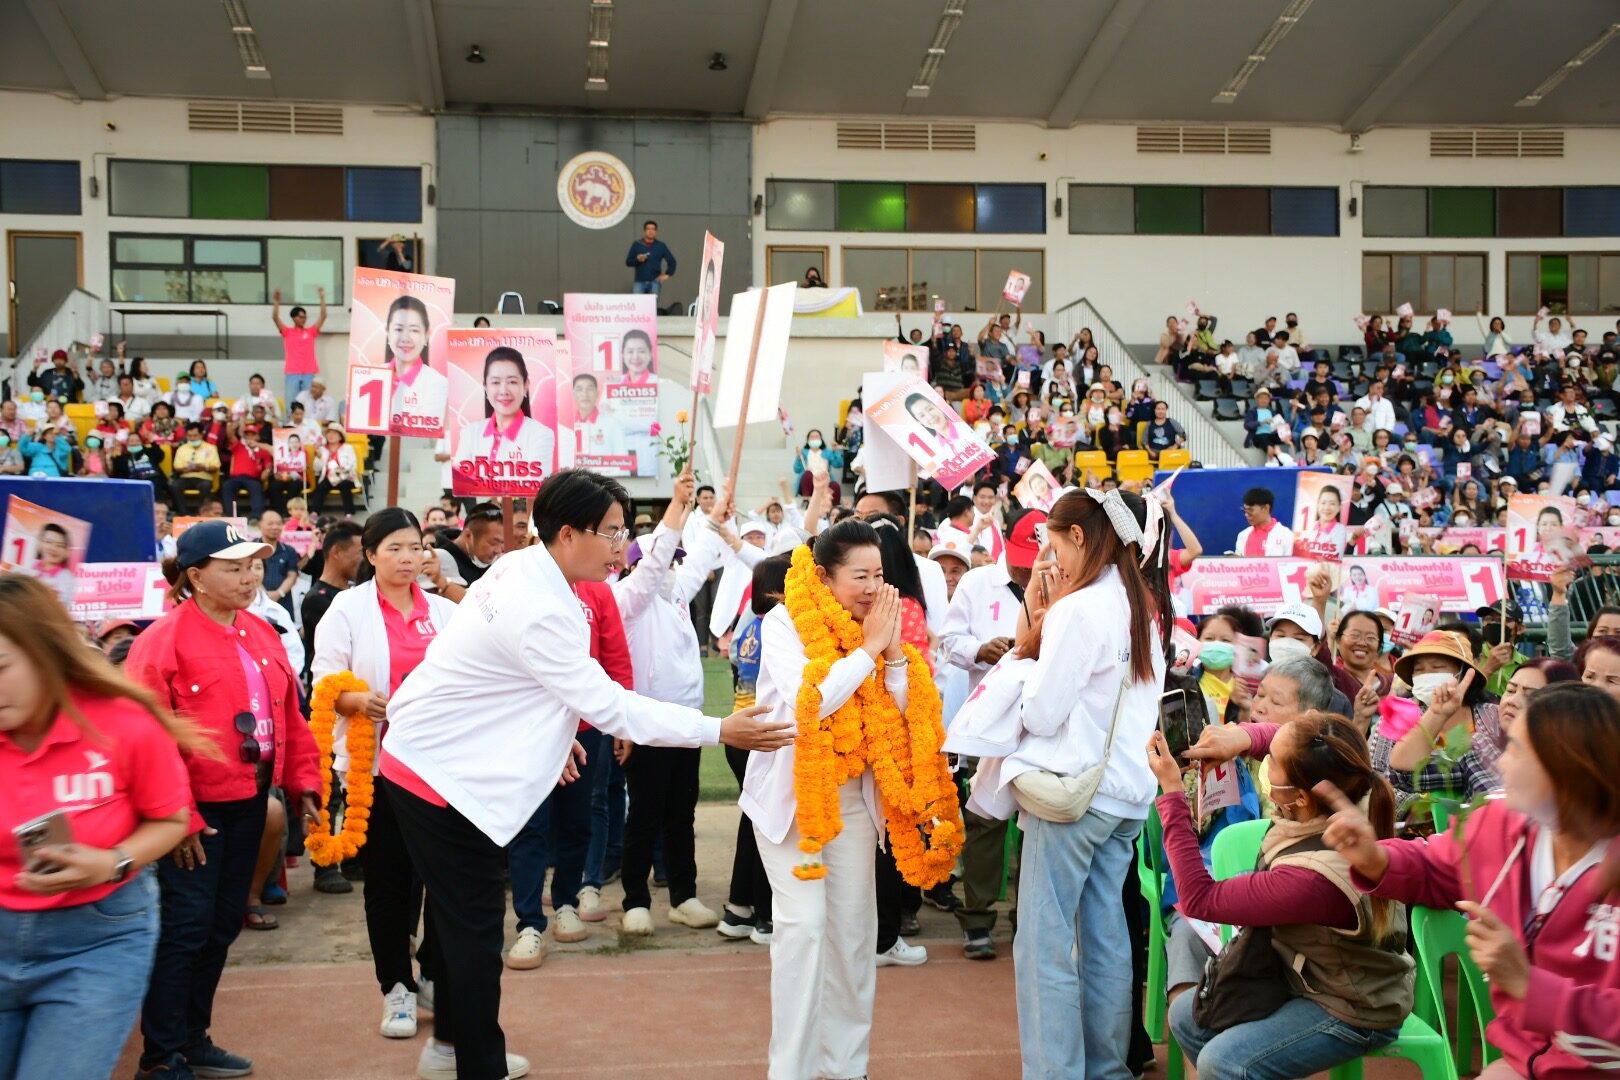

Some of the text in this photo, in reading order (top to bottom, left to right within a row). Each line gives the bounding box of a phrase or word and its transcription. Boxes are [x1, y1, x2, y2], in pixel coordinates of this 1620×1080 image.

[598, 340, 612, 370] 1
[359, 379, 383, 427] 1
[908, 432, 936, 458] 1
[459, 456, 543, 478] อทิตาธร
[12, 538, 26, 565] 1
[1515, 528, 1526, 552] 1
[1470, 566, 1500, 607] 1
[989, 601, 1000, 621] 1
[1402, 612, 1411, 629] 1
